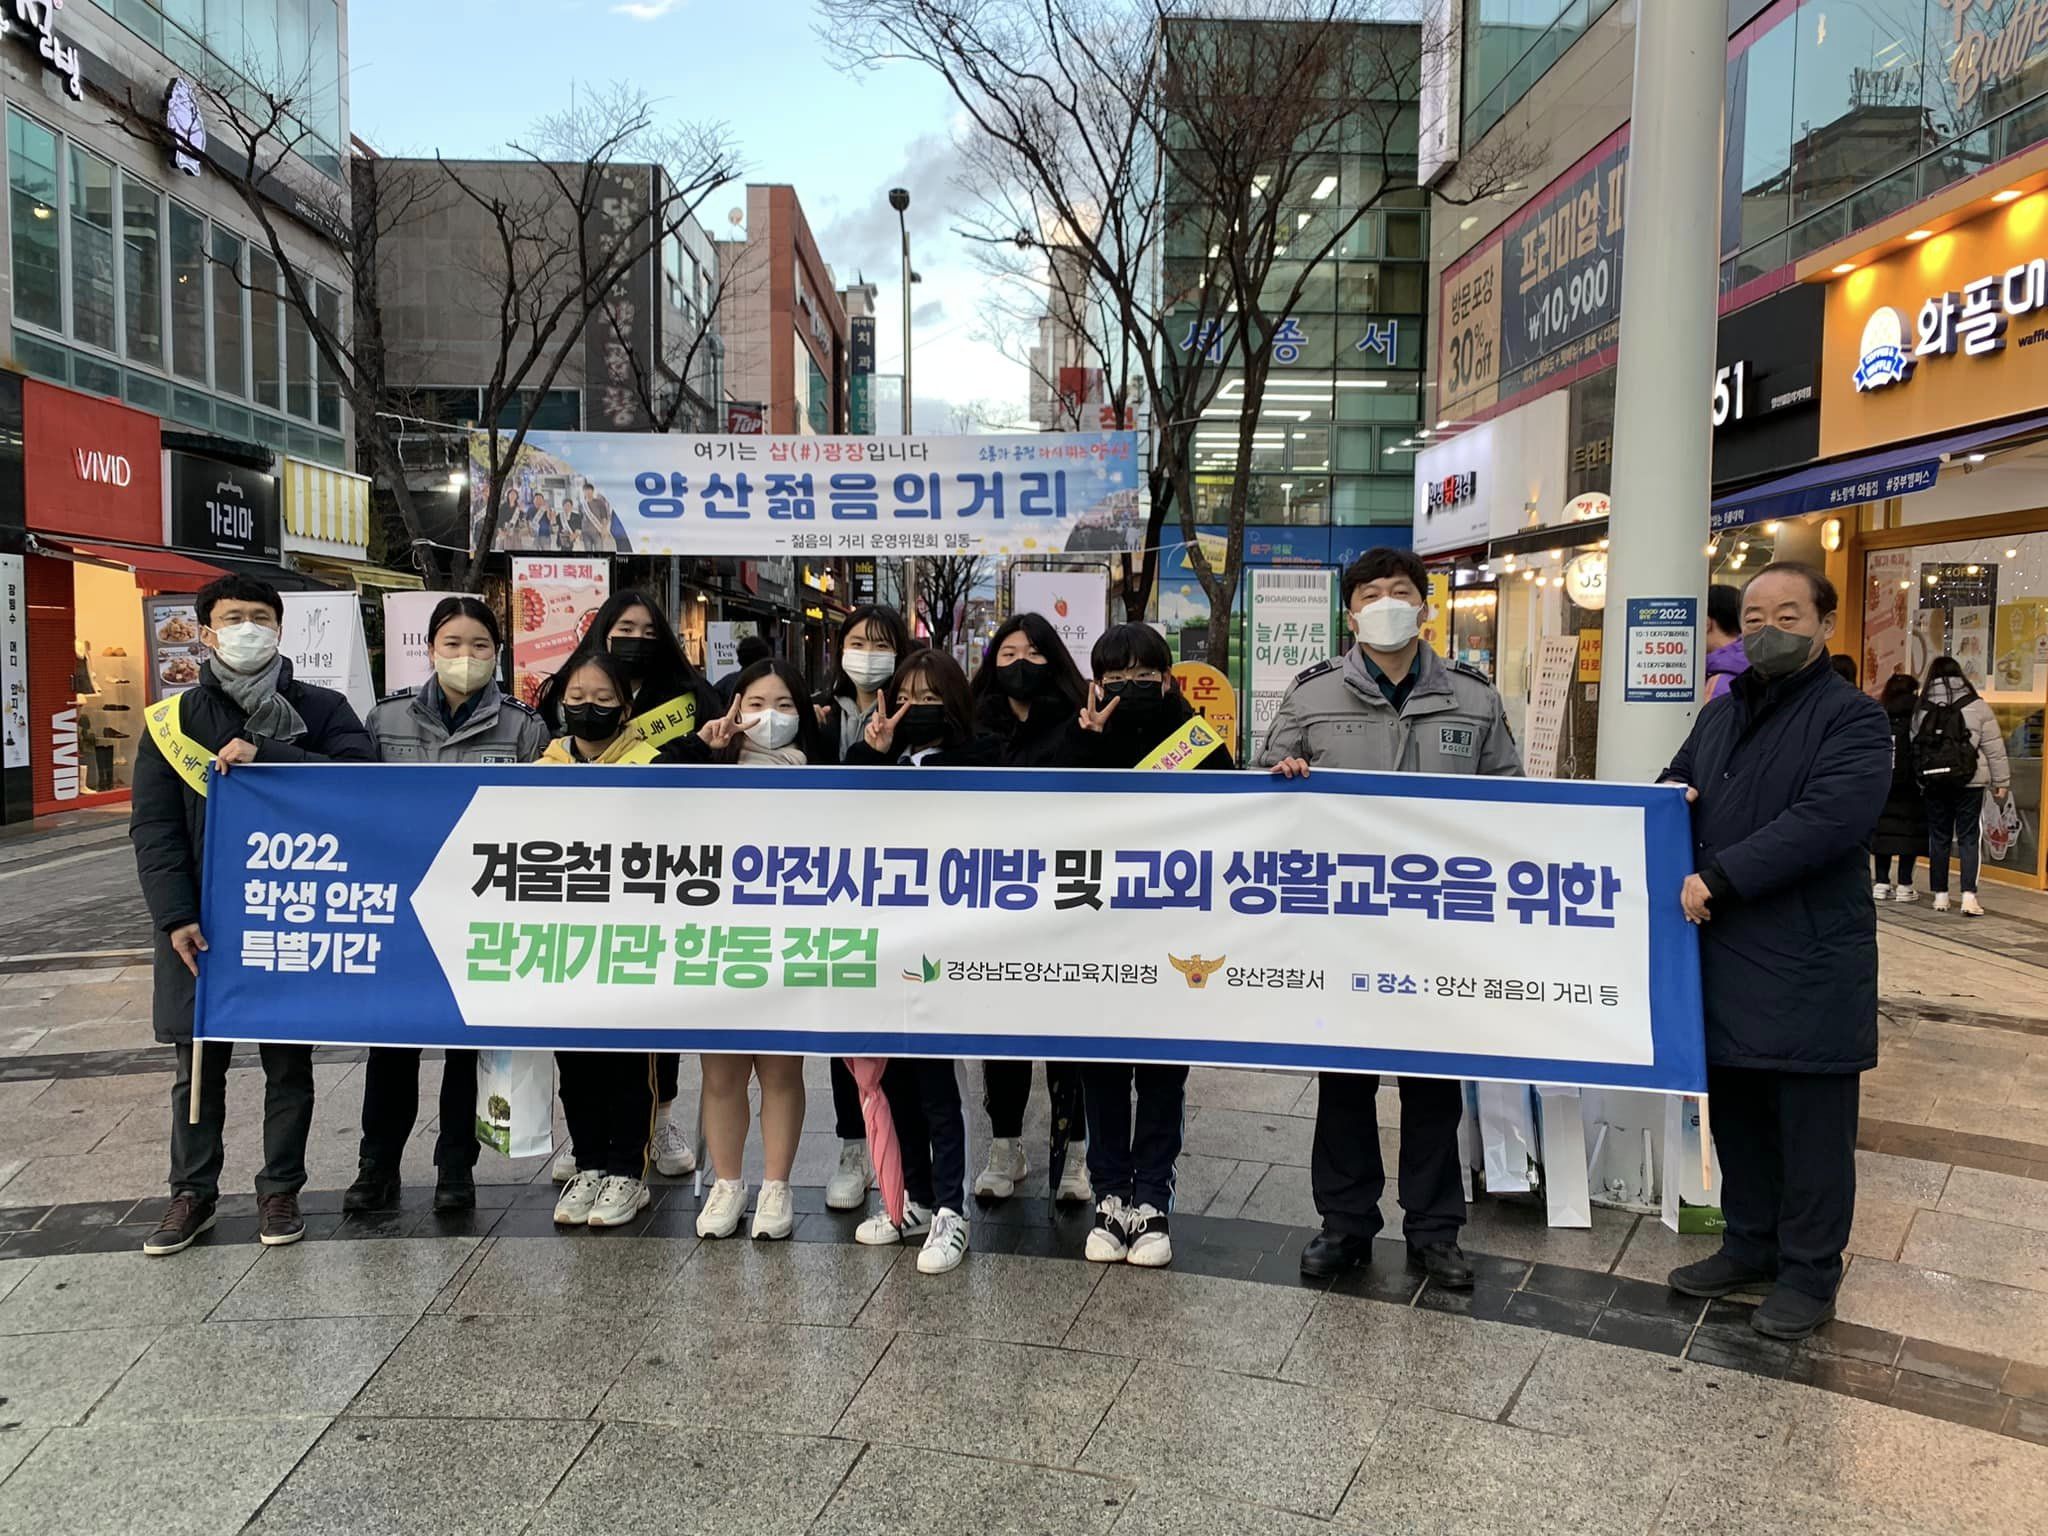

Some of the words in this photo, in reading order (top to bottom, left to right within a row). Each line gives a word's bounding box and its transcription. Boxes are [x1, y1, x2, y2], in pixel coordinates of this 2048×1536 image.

[1519, 181, 1601, 296] 프리미엄
[1451, 264, 1494, 327] 방문포장
[1475, 339, 1493, 381] off
[76, 447, 131, 487] VIVID
[694, 442, 757, 462] 여기는
[769, 441, 929, 462] 샵(#)광장입니다
[205, 500, 253, 541] 가리마
[791, 534, 833, 549] 젊음의
[838, 534, 865, 550] 거리
[870, 534, 939, 549] 운영위원회
[528, 563, 558, 579] 딸기
[563, 563, 593, 579] 축제
[1255, 622, 1327, 643] 늘/푸/른
[1659, 608, 1688, 620] 2022
[295, 652, 334, 669] 더네일
[1255, 646, 1326, 667] 여/행/사
[52, 708, 79, 801] VIVID
[246, 832, 348, 872] 2022.
[243, 880, 316, 922] 학생
[325, 882, 398, 925] 안전
[470, 840, 612, 903] 겨울철
[621, 842, 723, 907] 학생
[731, 844, 930, 908] 안전사고
[939, 847, 1046, 911] 예방
[1054, 849, 1104, 912] 및
[1110, 850, 1213, 912] 교외
[1222, 849, 1497, 923] 생활교육을
[1507, 860, 1622, 929] 위한
[240, 931, 381, 975] 특별기간
[465, 922, 666, 985] 관계기관
[673, 924, 772, 989] 합동
[781, 926, 880, 988] 점검
[946, 959, 1159, 985] 경상남도양산교육지원청
[1225, 965, 1325, 991] 양산경찰서
[1434, 975, 1477, 999] 양산
[1483, 977, 1546, 1002] 젊음의
[1553, 981, 1593, 1005] 거리
[1599, 984, 1619, 1007] 등
